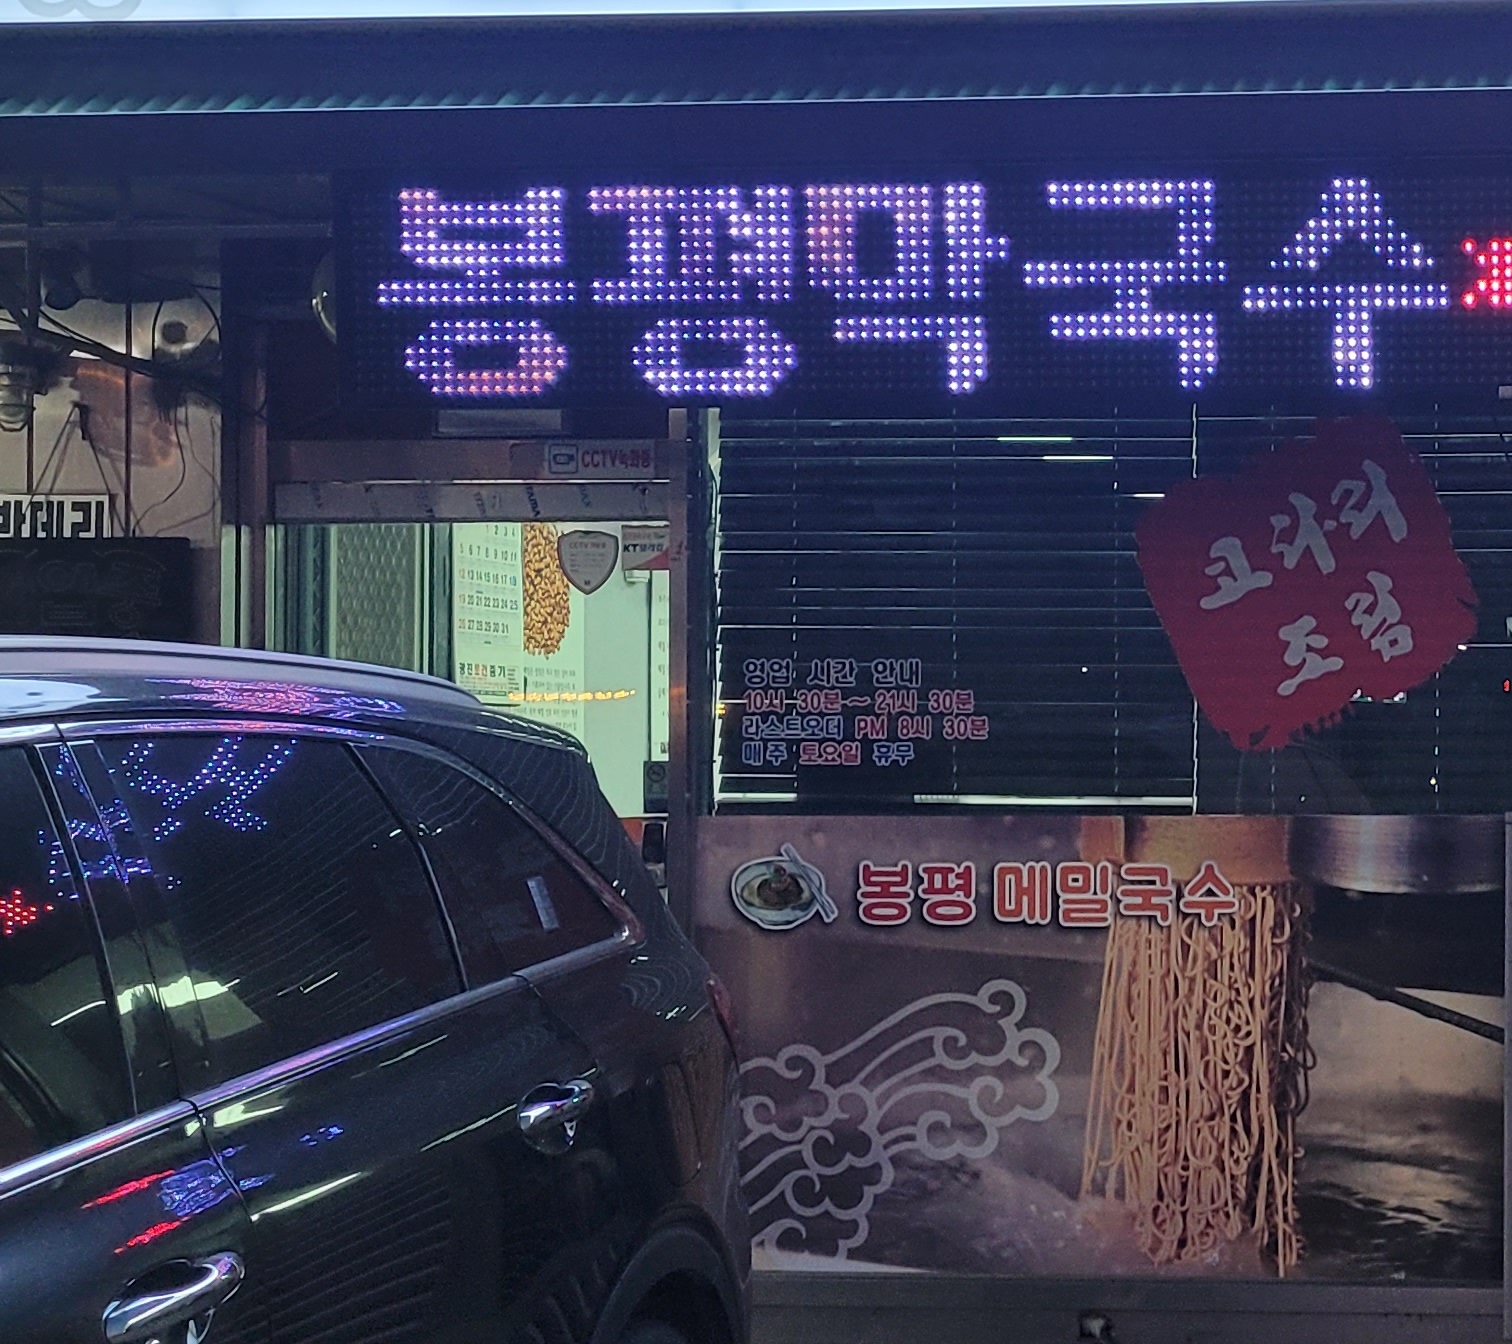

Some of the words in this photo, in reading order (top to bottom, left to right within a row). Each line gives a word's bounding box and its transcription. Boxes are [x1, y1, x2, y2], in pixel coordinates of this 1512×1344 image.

[377, 178, 1451, 396] 봉평막국수
[1200, 459, 1408, 610] 코다리
[1277, 570, 1413, 697] 조림
[743, 658, 792, 686] 영업
[807, 658, 857, 686] 시간
[871, 658, 922, 687] 안내
[744, 689, 786, 713] 10시
[928, 689, 974, 713] 30분
[742, 715, 843, 739] 라스트오더
[855, 716, 888, 739] PM
[898, 716, 932, 739] 8시
[943, 716, 989, 739] 30분
[799, 741, 861, 765] 토요일
[872, 741, 915, 766] 휴무
[857, 860, 976, 926] 봉평
[993, 860, 1239, 928] 메밀국수
